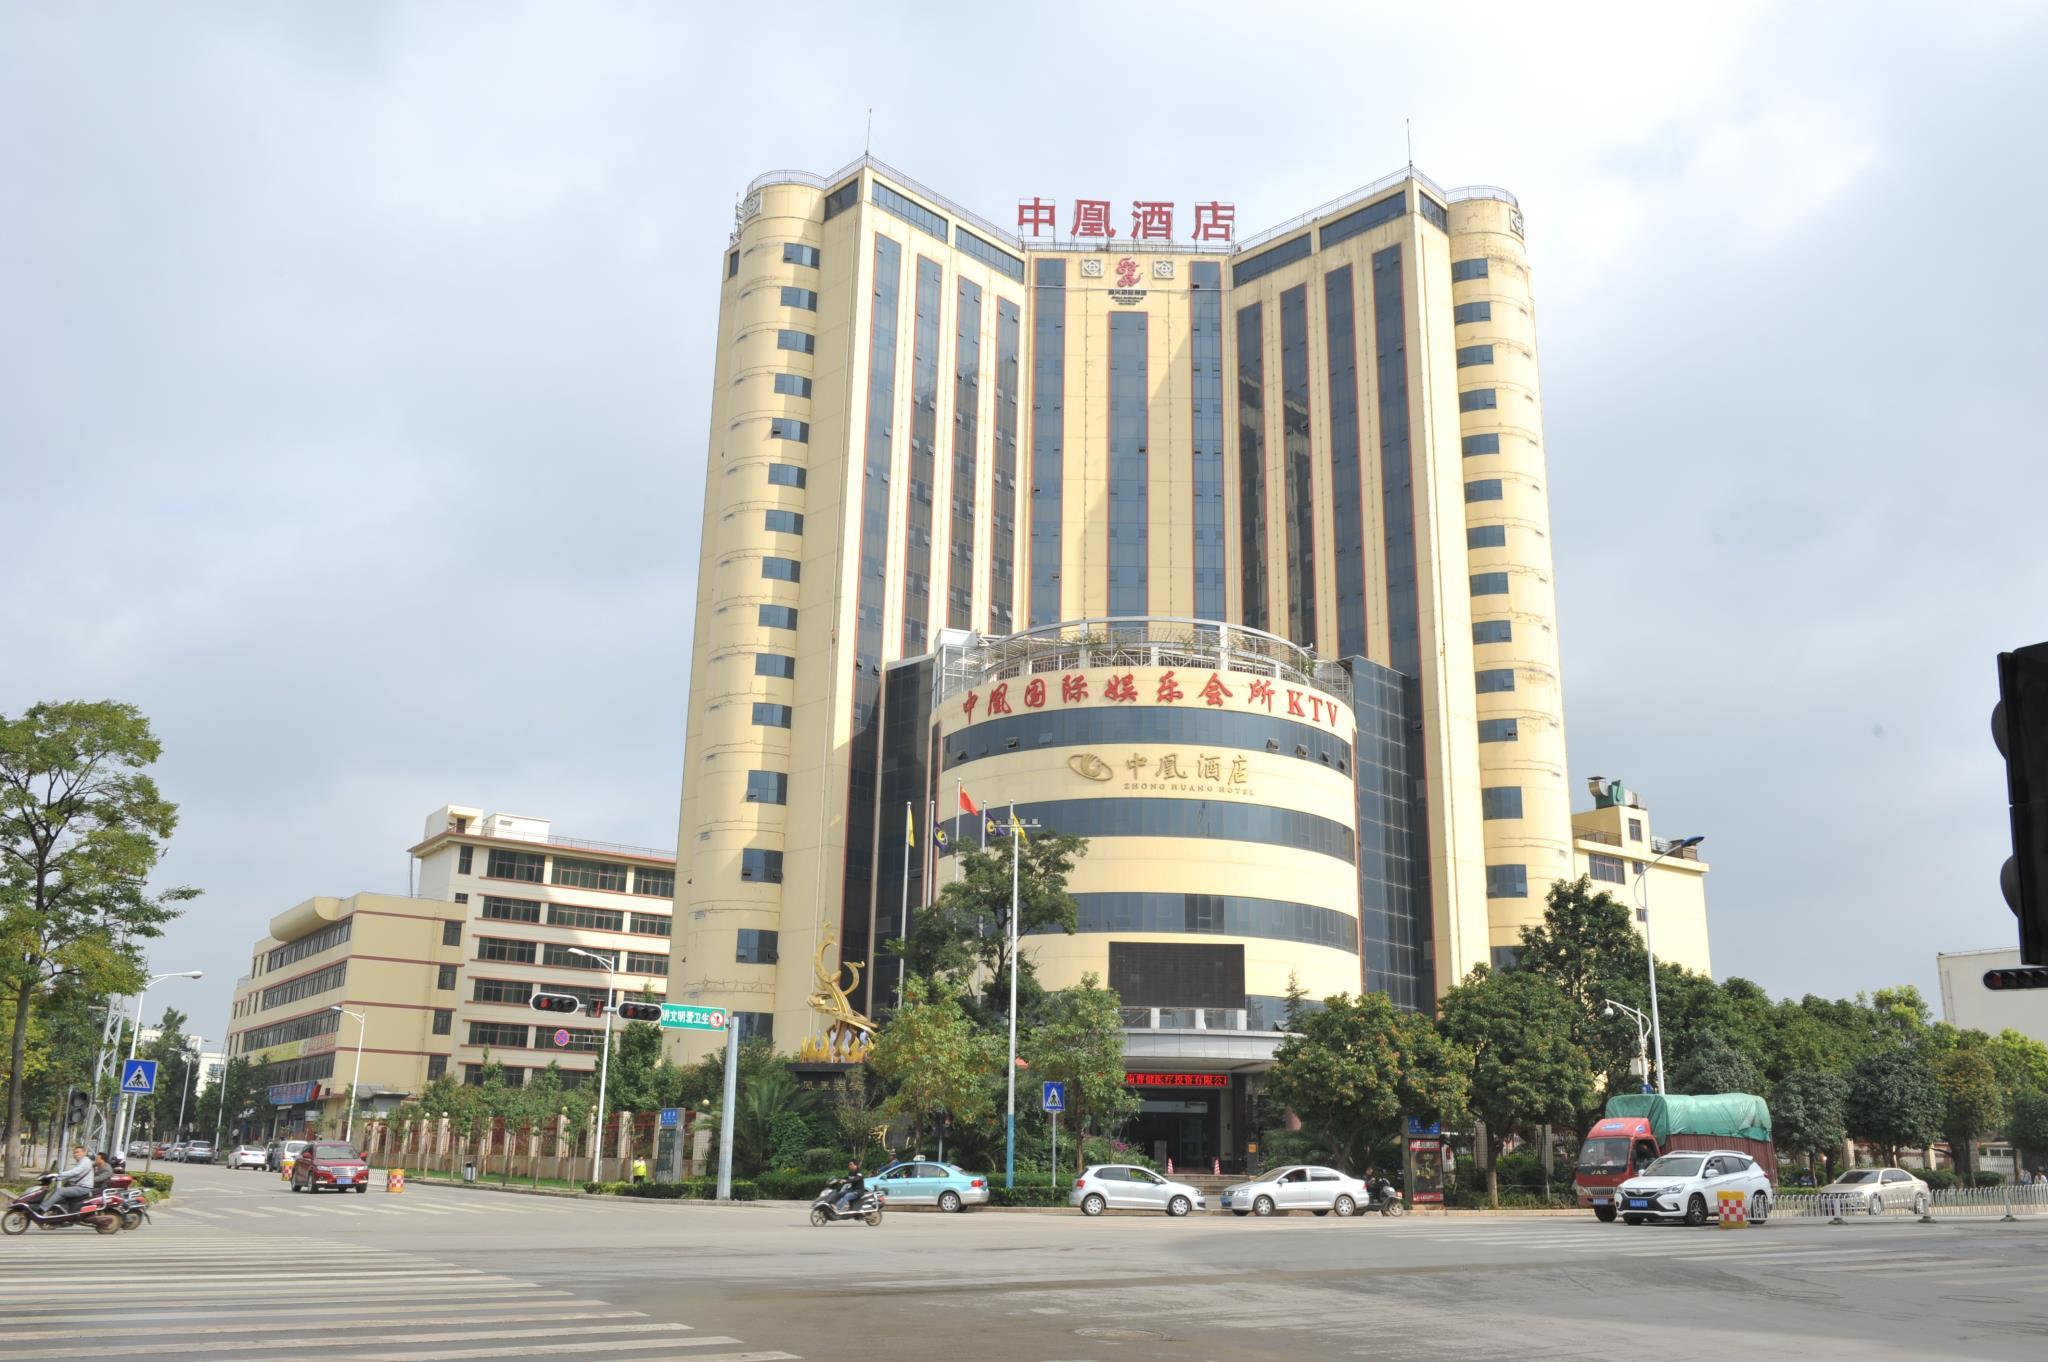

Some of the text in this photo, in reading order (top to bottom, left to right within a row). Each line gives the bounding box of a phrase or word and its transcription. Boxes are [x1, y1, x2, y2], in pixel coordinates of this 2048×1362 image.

[1017, 196, 1235, 241] 中凰酒店
[1125, 752, 1248, 785] 中凰酒店
[1171, 784, 1213, 792] HUANG
[1218, 786, 1255, 796] HOTEL
